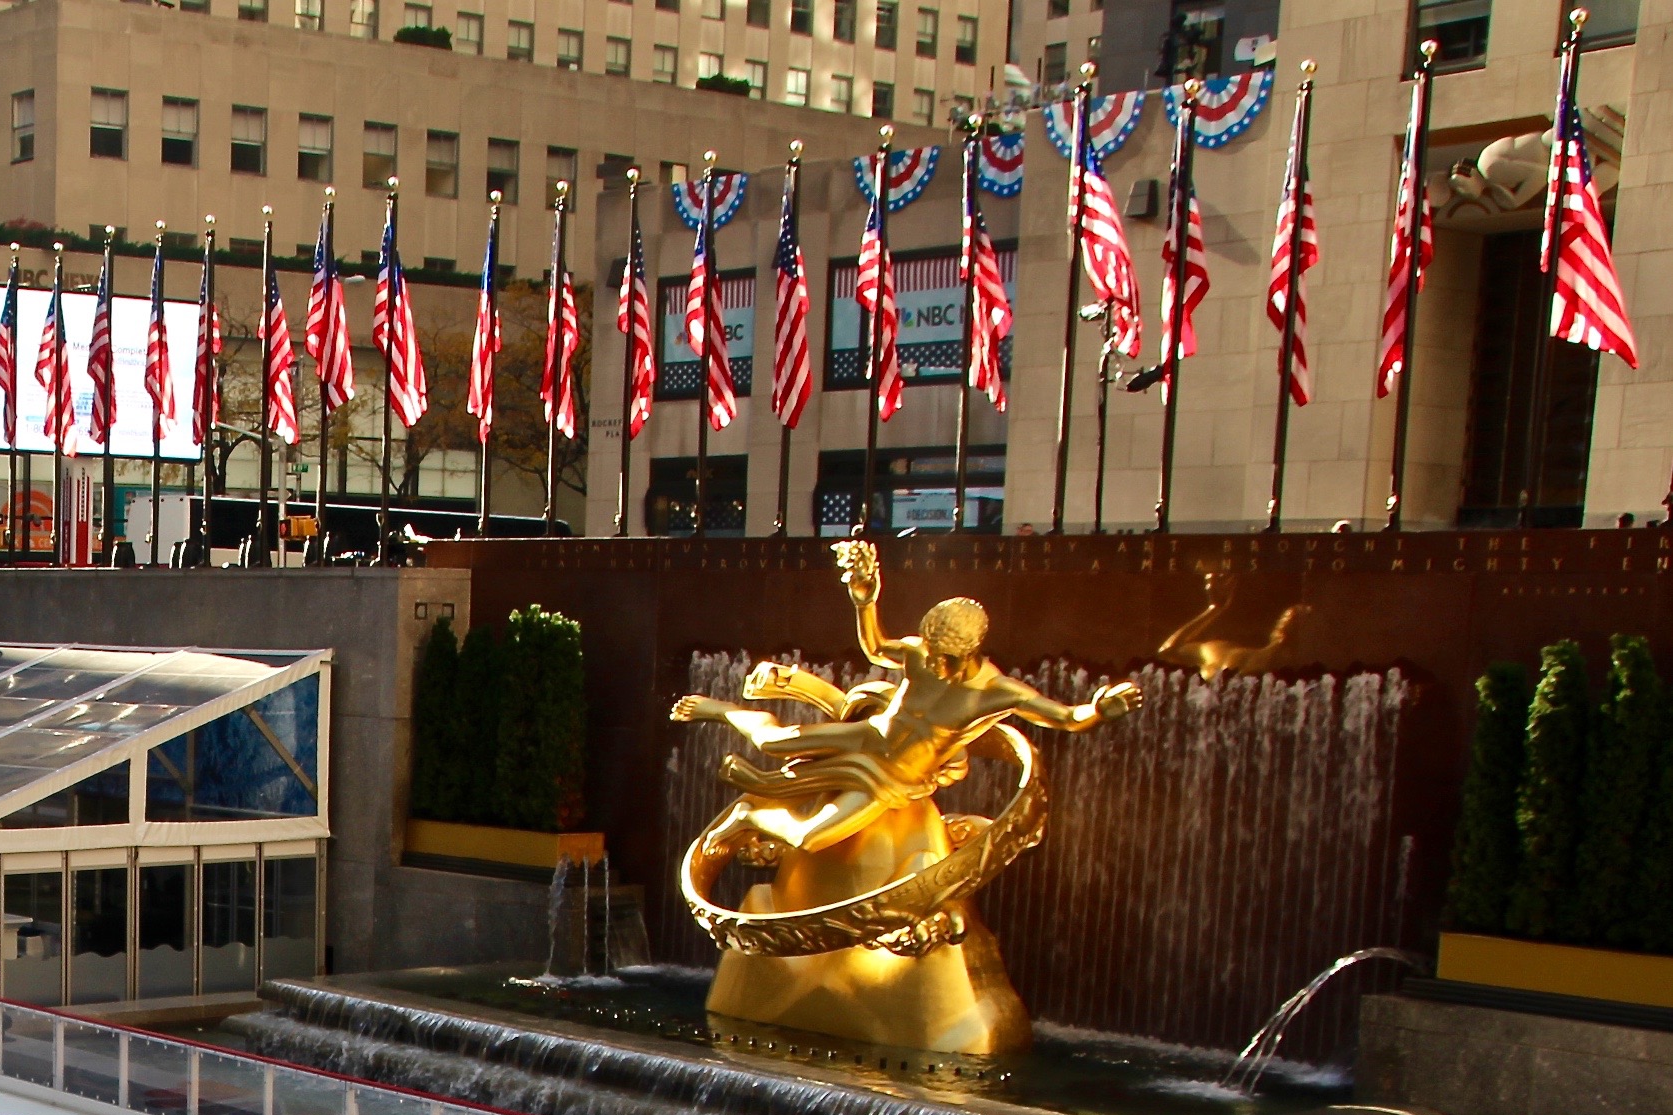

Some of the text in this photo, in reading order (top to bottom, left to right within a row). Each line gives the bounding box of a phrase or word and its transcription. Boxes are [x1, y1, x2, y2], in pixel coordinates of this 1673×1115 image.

[916, 303, 955, 327] NBC
[723, 323, 744, 341] BC
[741, 542, 829, 553] TEACH
[973, 541, 1076, 553] EVERY
[1117, 540, 1179, 552] ART
[1456, 537, 1529, 551] THE
[1588, 536, 1672, 549] FIR
[1140, 558, 1259, 571] MEANS
[1304, 558, 1346, 571] TO
[1621, 556, 1669, 572] EN
